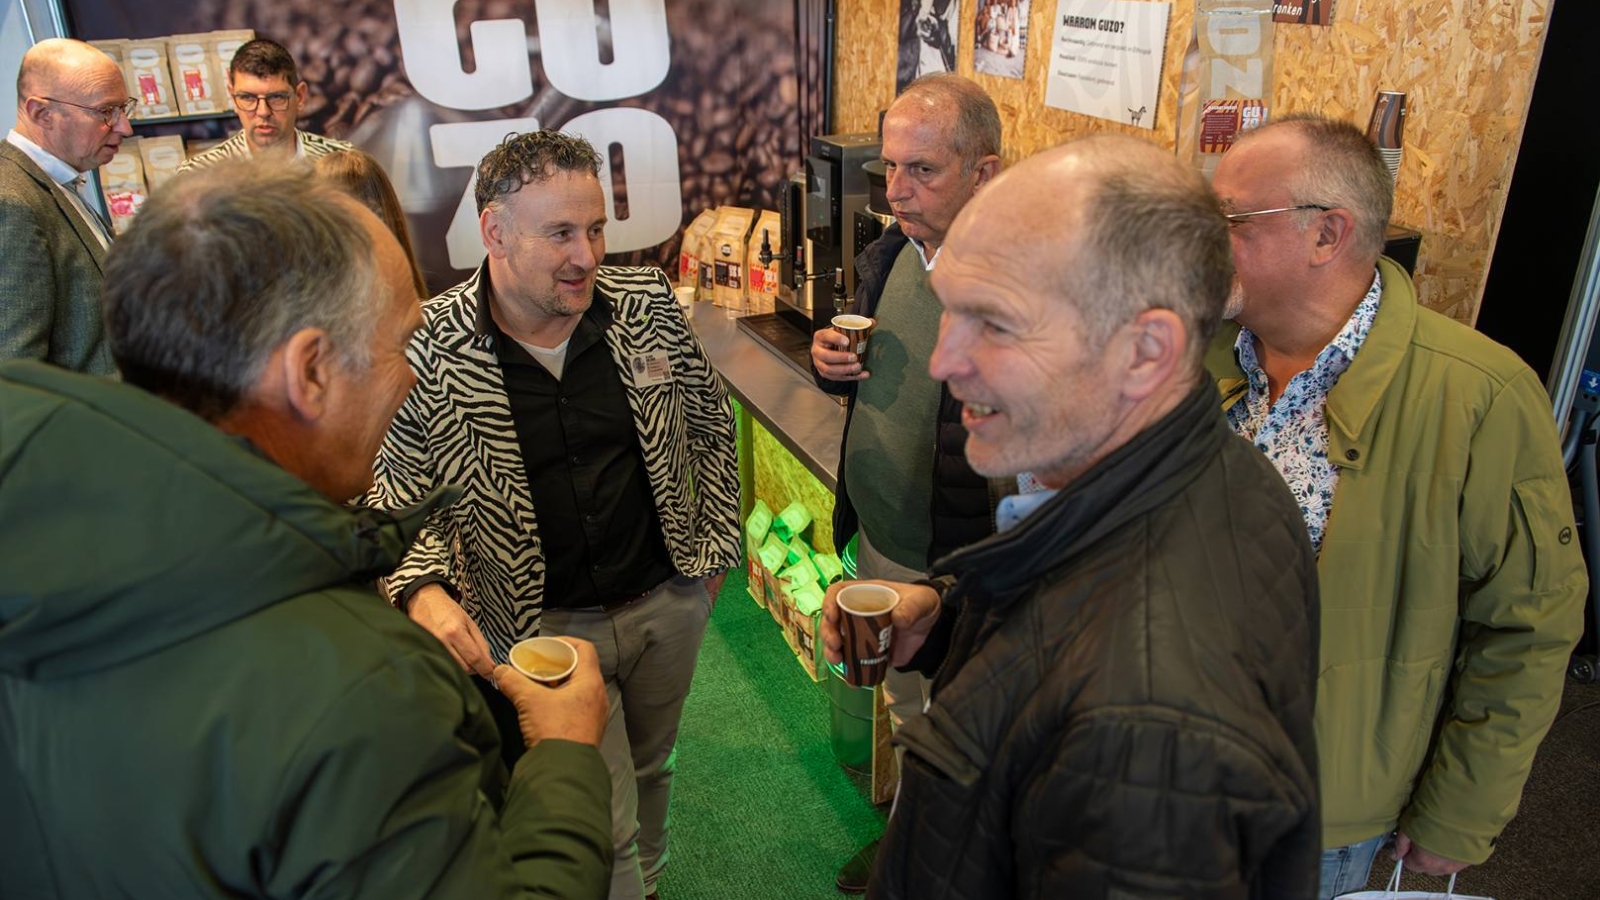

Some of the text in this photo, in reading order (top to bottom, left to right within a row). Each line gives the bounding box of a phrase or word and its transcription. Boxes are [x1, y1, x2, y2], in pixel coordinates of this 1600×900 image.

[1273, 3, 1303, 16] ronken
[1062, 14, 1125, 34] WAAROM GUZO?
